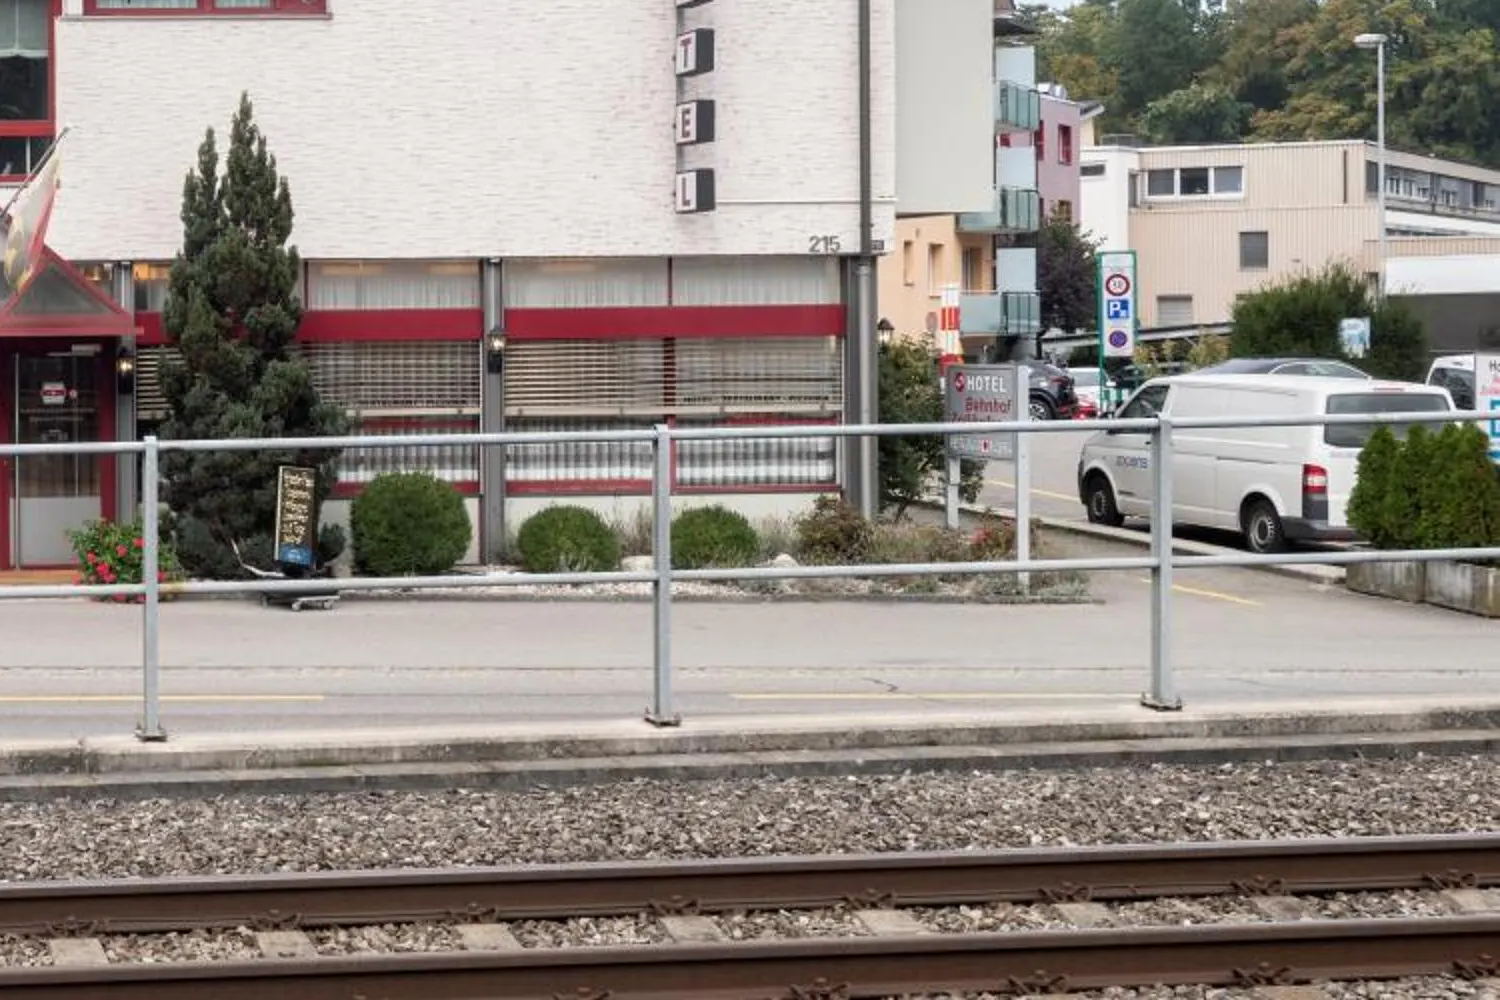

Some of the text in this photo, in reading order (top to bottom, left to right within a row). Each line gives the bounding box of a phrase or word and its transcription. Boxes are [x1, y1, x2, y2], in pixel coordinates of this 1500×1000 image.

[808, 235, 841, 252] 215
[1109, 301, 1120, 317] P
[966, 375, 1006, 393] HOTEL
